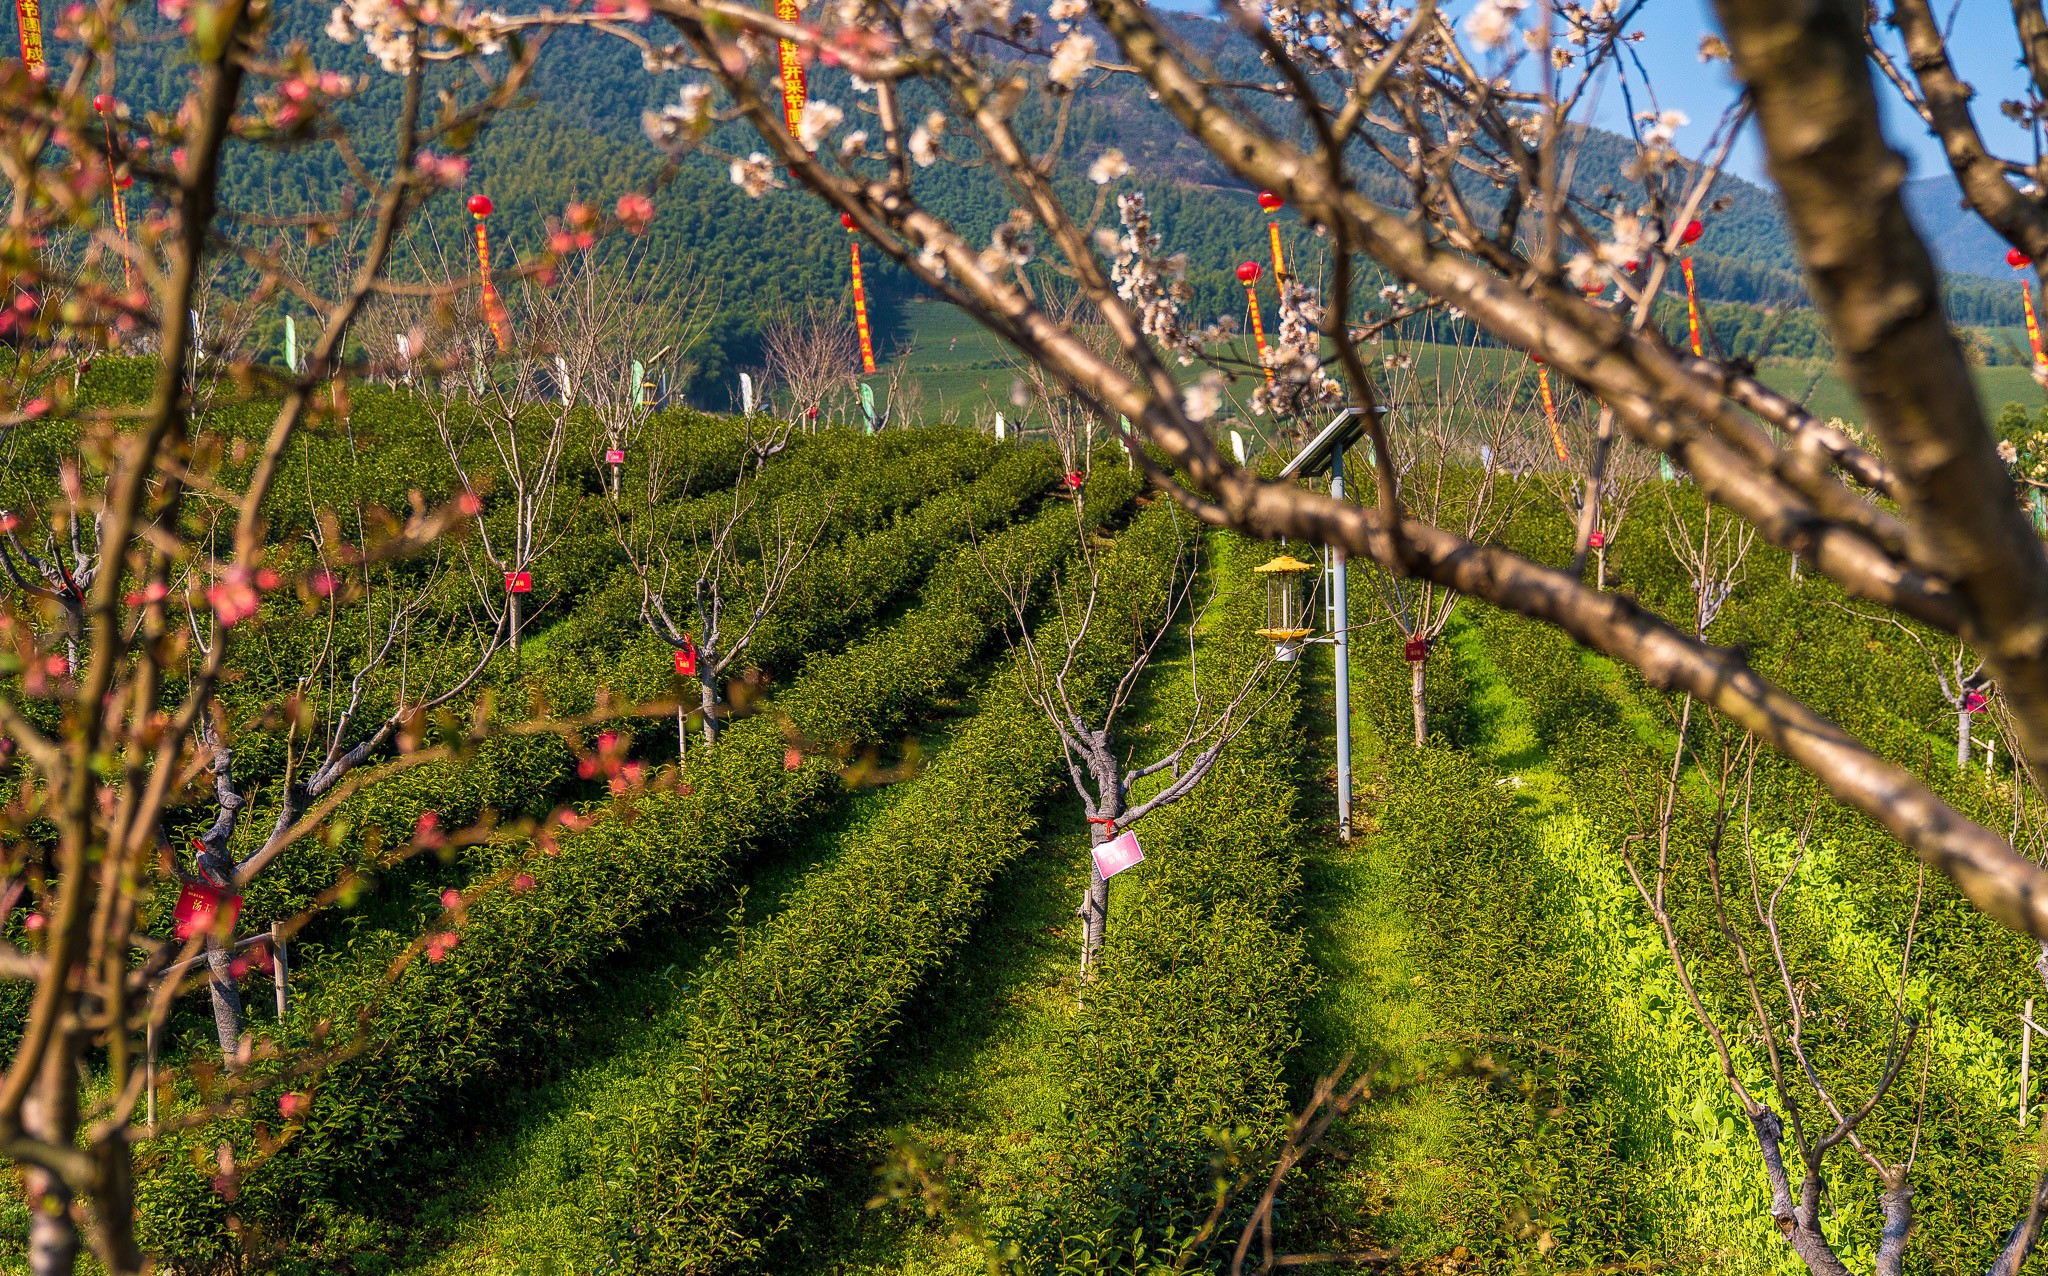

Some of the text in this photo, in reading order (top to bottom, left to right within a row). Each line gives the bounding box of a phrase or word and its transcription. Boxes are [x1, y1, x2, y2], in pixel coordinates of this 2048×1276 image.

[20, 0, 45, 73] 节圆满成功
